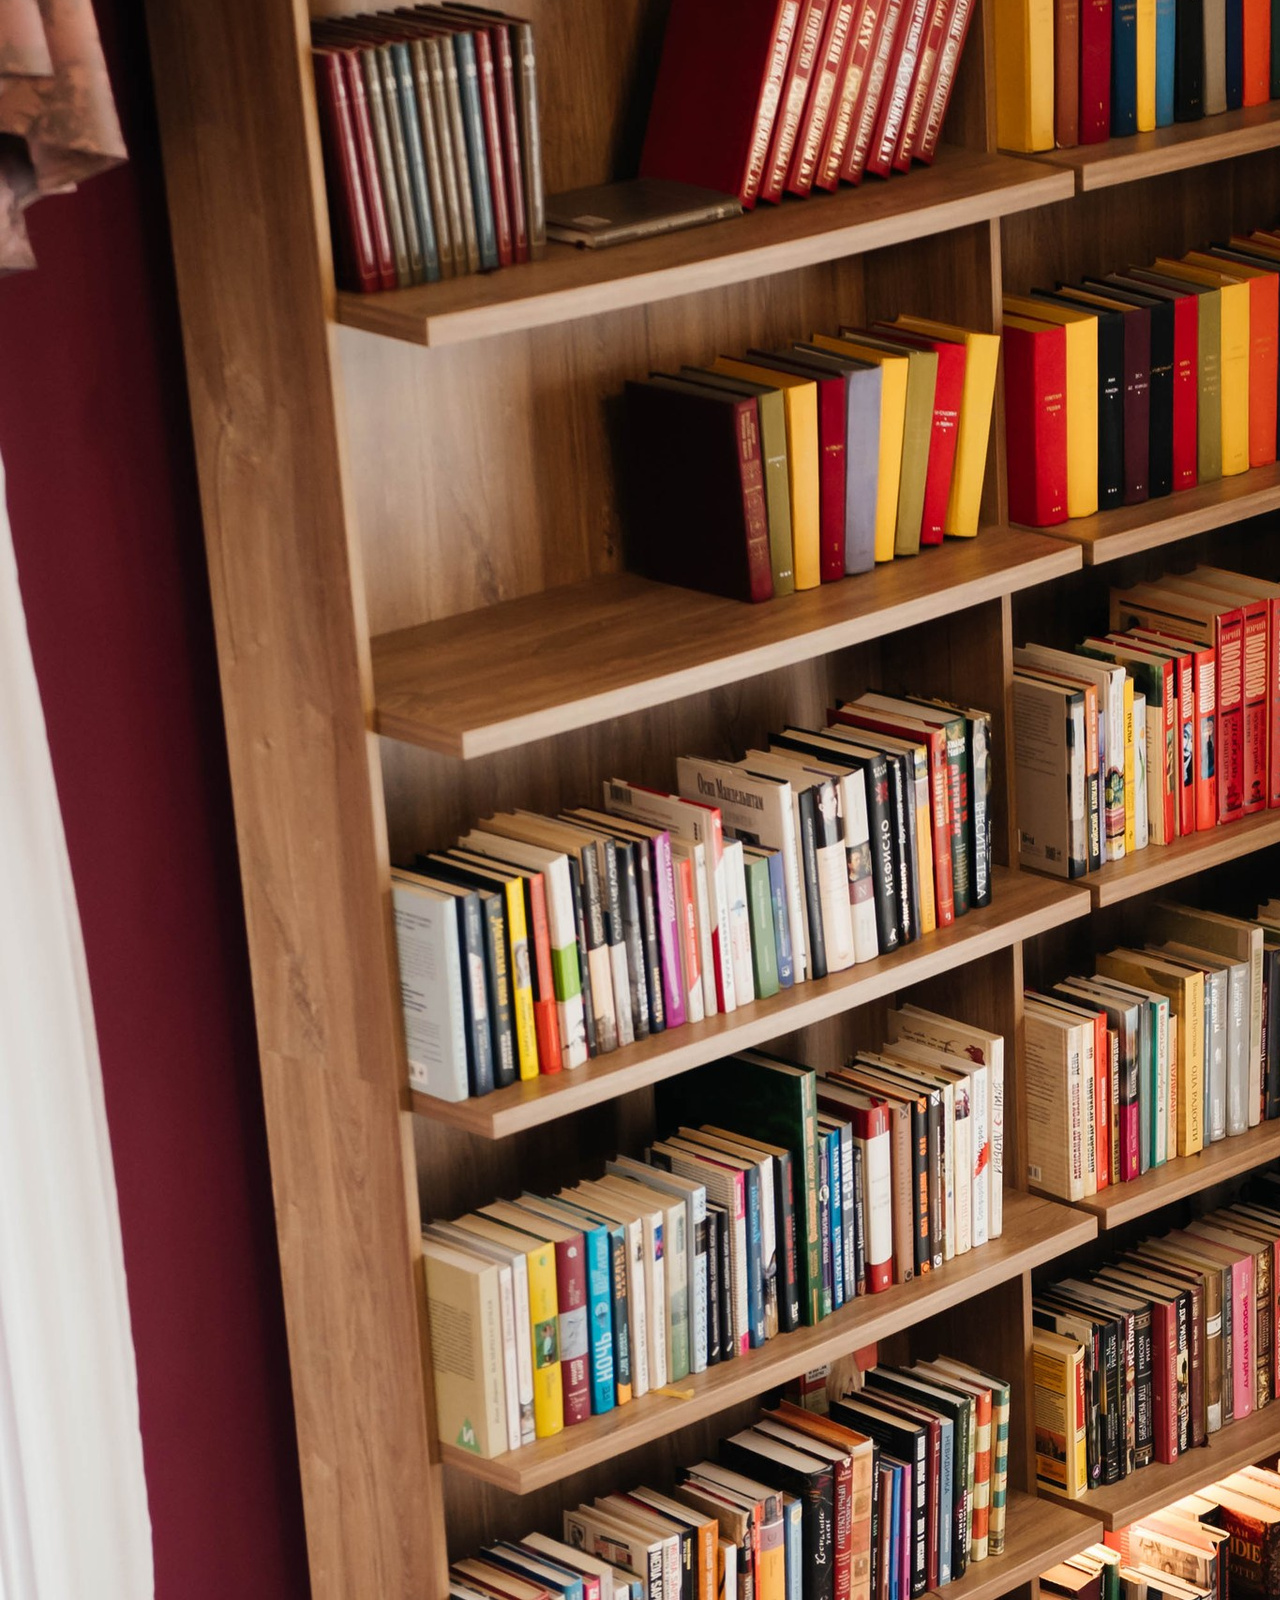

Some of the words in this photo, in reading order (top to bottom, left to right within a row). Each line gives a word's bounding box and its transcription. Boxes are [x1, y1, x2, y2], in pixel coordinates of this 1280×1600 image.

[799, 8, 821, 69] ОКАЗИОН
[828, 4, 852, 63] ИВЕРЕНЬ
[858, 5, 876, 50] АХРУ
[1199, 662, 1214, 714] ПОЛЯКОВ
[1221, 641, 1241, 706] ПОЛЯКОВ
[1245, 633, 1266, 698] ПОЛЯКОВ
[1182, 668, 1192, 718] ПОЛЯКОВ
[696, 772, 716, 792] Осип
[718, 778, 764, 811] Мандельштам
[1091, 780, 1099, 810] КАПКАН
[975, 801, 985, 857] ВНЕСИТЕ
[1090, 813, 1099, 856] СИРИЙСКИЙ
[976, 861, 986, 899] ТЕЛА
[596, 1332, 613, 1382] НОЧЬ
[837, 1485, 846, 1549] ЛИТЕРАТУРНЫЙ
[650, 1551, 661, 1581] MEDIA
